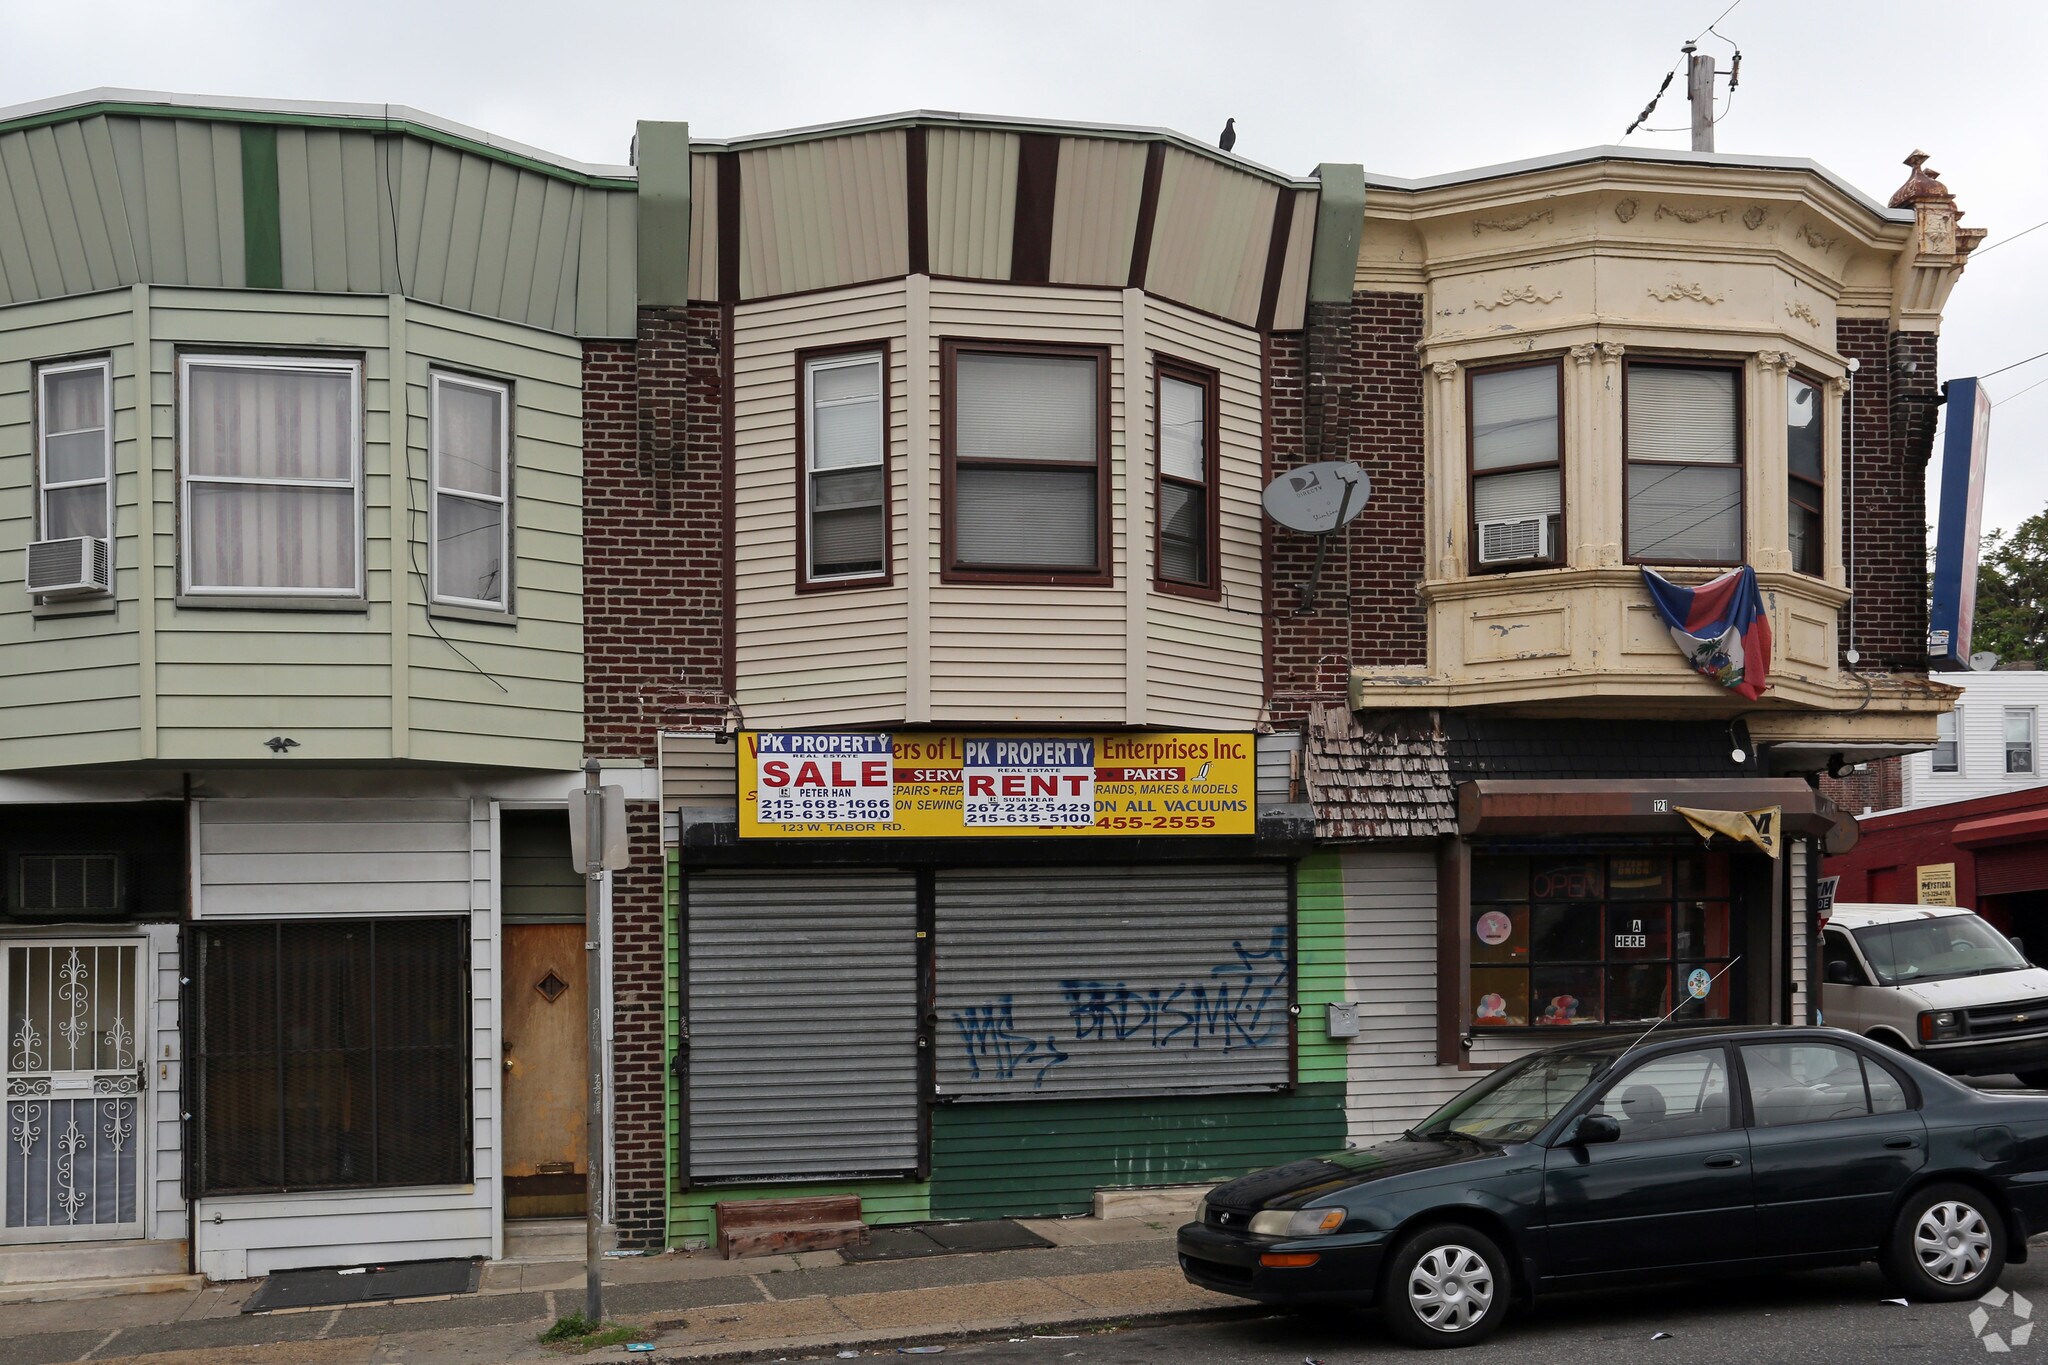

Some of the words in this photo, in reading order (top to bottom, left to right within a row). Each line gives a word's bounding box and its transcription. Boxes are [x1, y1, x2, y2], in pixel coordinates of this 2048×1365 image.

[760, 736, 788, 752] PK
[792, 736, 889, 752] PROPERTY
[927, 737, 946, 759] of
[951, 738, 961, 759] L
[1103, 738, 1208, 764] Enterprises
[1214, 738, 1246, 759] Inc.
[966, 742, 990, 765] PK
[997, 742, 1091, 765] PROPERTY
[762, 761, 888, 787] SALE
[1123, 768, 1178, 781] PARTS
[940, 785, 964, 796] REP
[1094, 784, 1137, 796] RANDS,
[1140, 784, 1179, 794] MAKES
[1182, 784, 1189, 794] &
[1191, 784, 1238, 794] MODELS
[968, 776, 1089, 796] RENT
[800, 789, 828, 798] PETER
[832, 789, 851, 797] HAN
[761, 800, 890, 809] 215-668-1666
[895, 800, 912, 810] ON
[917, 800, 963, 810] SEWING
[1094, 801, 1117, 812] ON
[1126, 800, 1157, 812] ALL
[1164, 800, 1248, 812] VACUUMS
[966, 803, 1091, 812] 267-242-5429
[762, 810, 890, 819] 215-635-5100
[967, 814, 1091, 823] 215-635-5100
[781, 824, 804, 832] 123
[807, 824, 822, 832] W.
[827, 823, 875, 832] TABOR
[882, 823, 905, 831] RD.
[1096, 816, 1216, 830] 455-2555
[1533, 873, 1600, 898] OPEN
[1615, 935, 1645, 947] HERE
